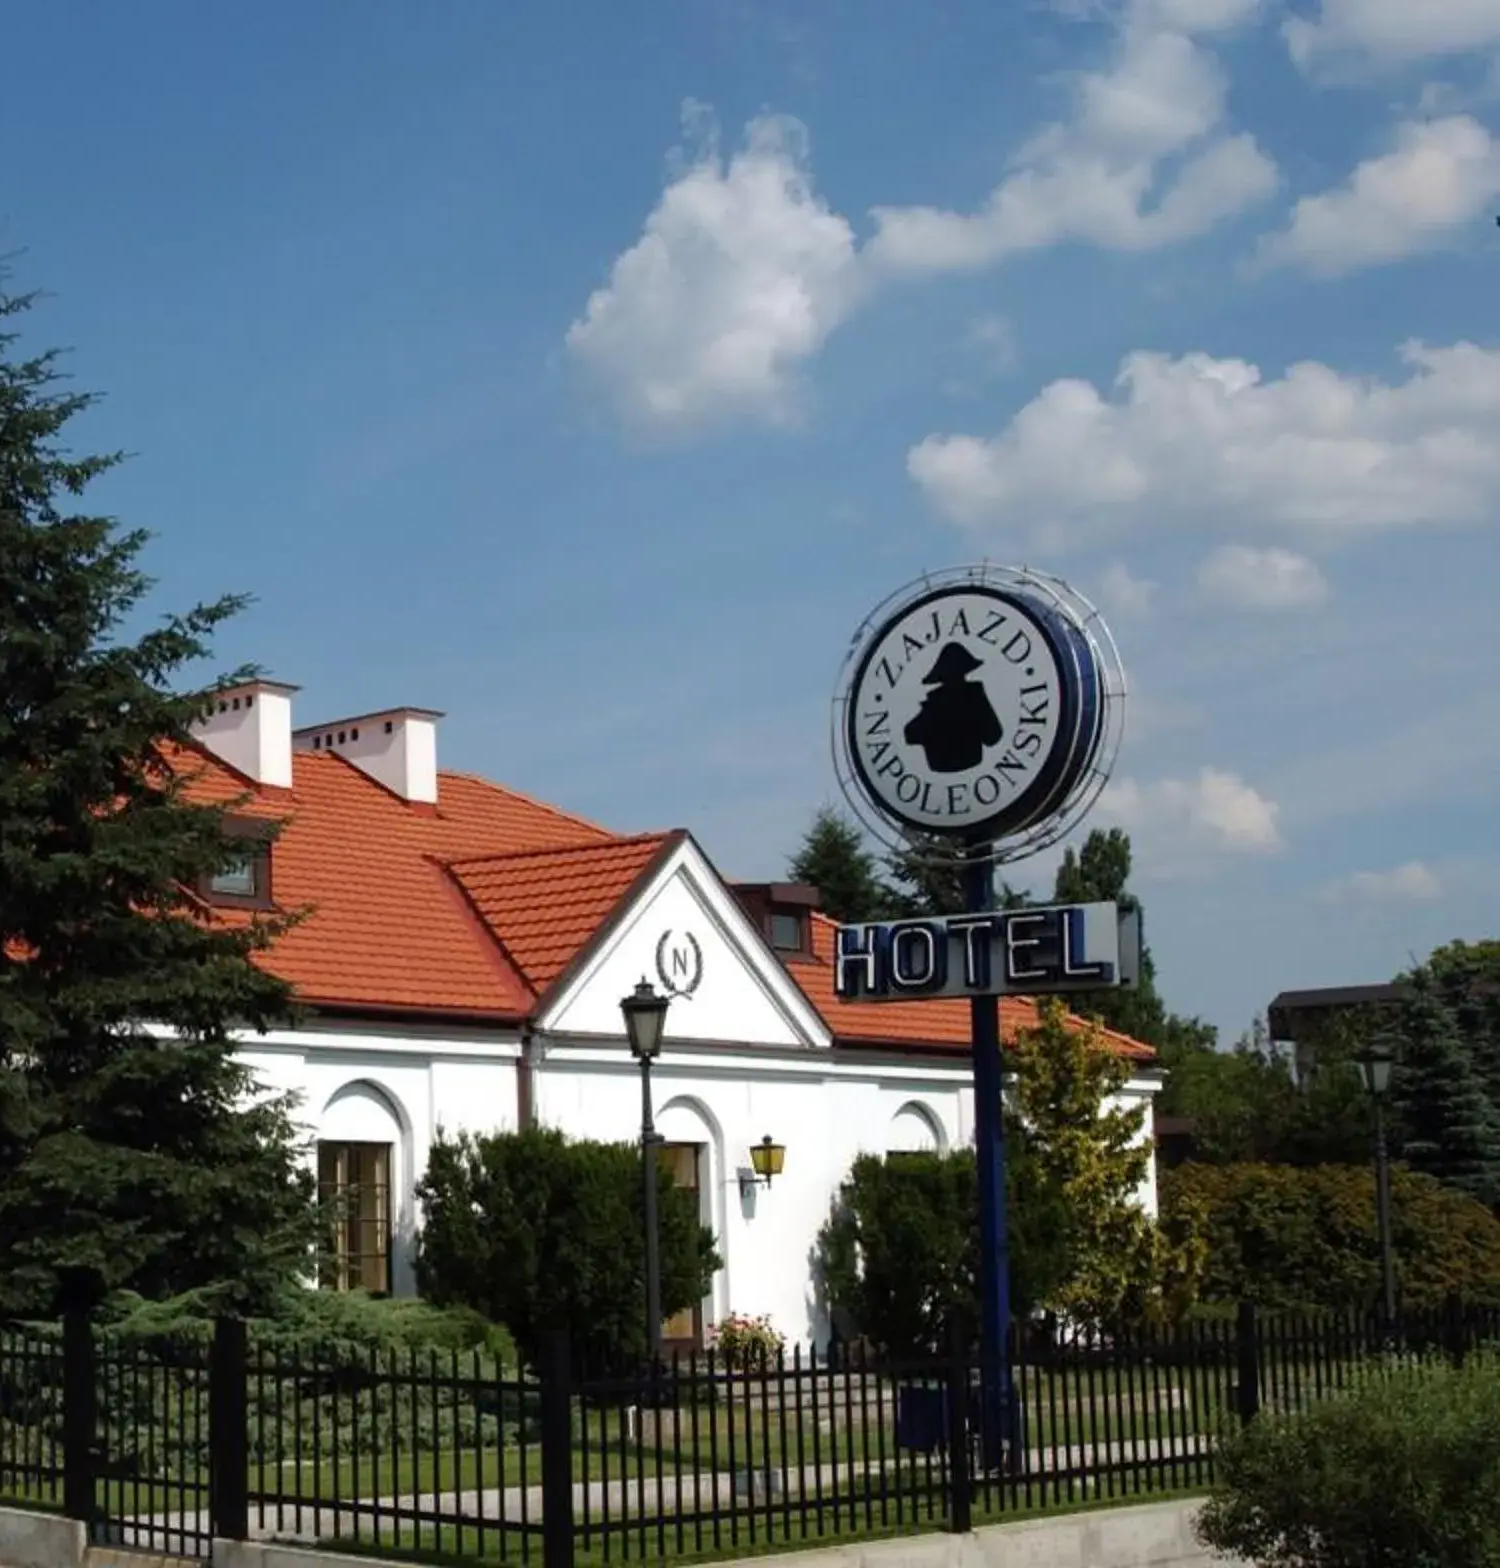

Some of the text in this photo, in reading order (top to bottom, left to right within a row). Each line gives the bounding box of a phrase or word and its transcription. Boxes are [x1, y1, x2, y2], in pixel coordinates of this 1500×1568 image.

[875, 608, 1032, 689] ZAJAZD
[672, 947, 687, 976] N
[835, 908, 1113, 997] HOTEL
